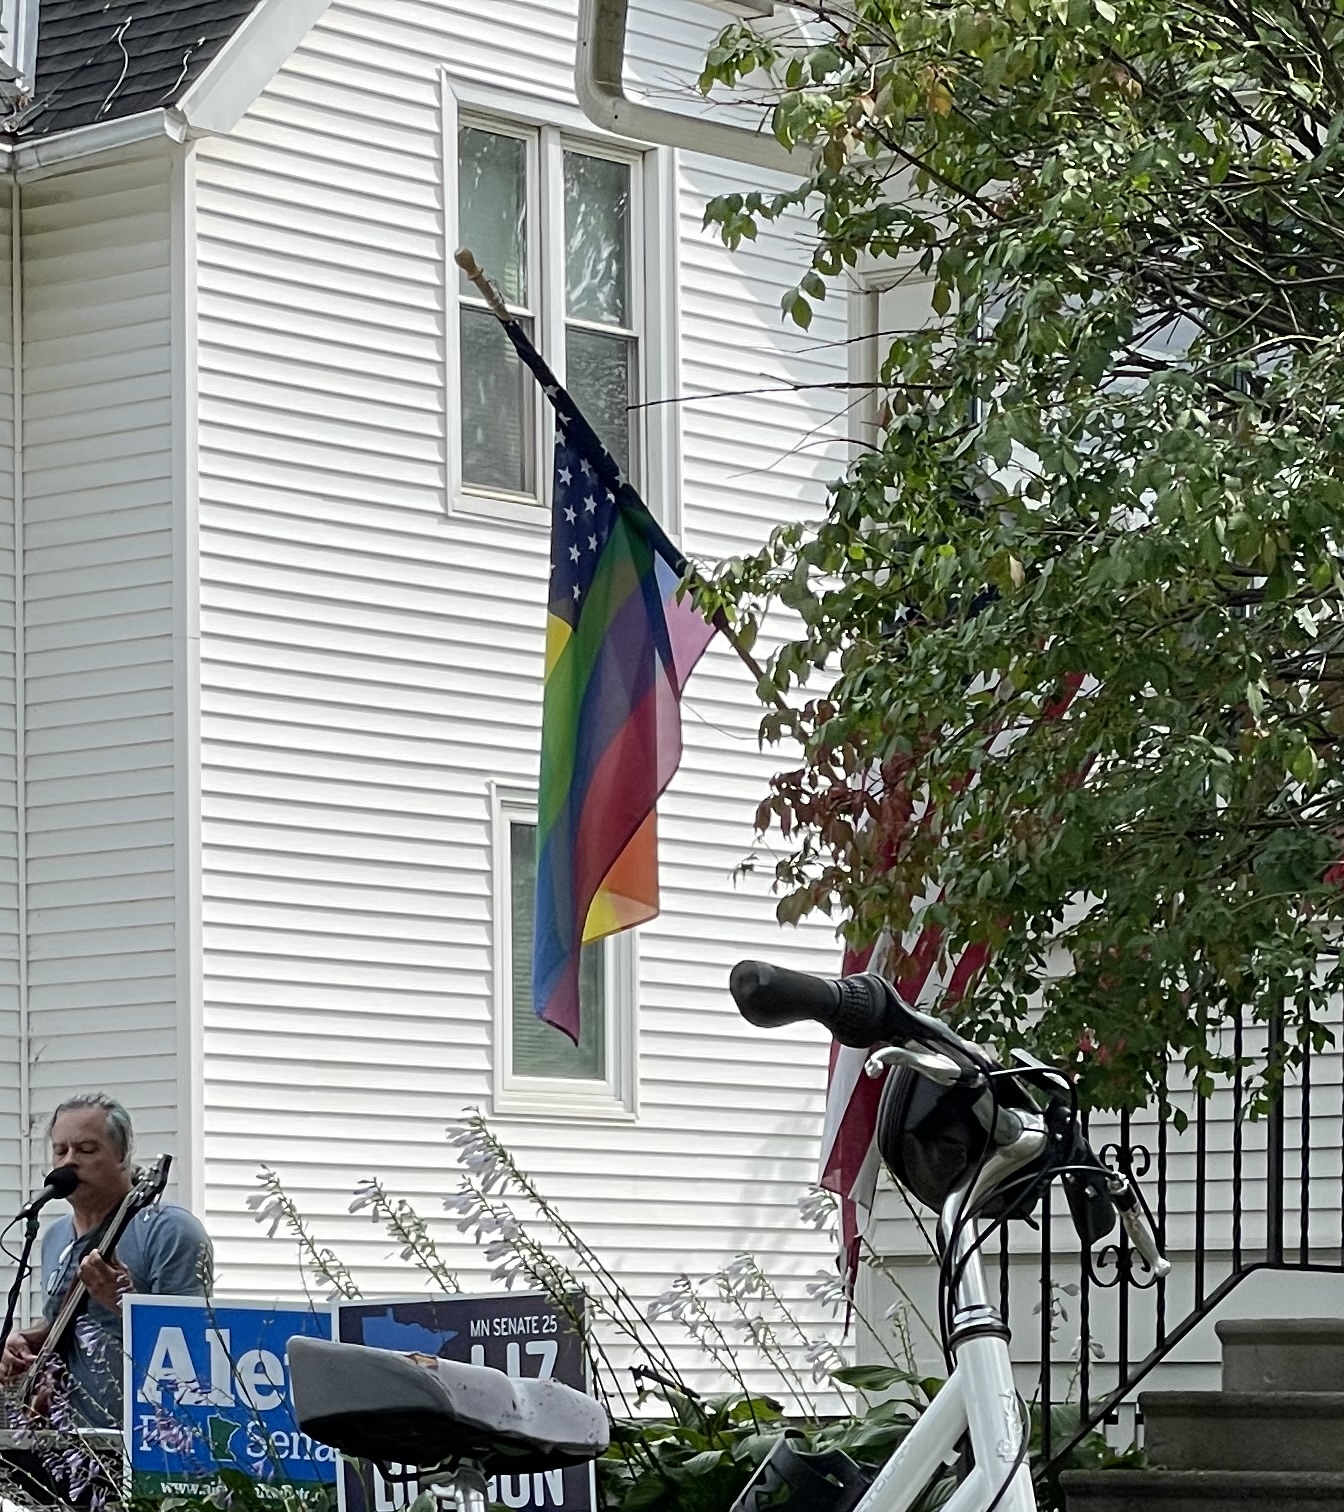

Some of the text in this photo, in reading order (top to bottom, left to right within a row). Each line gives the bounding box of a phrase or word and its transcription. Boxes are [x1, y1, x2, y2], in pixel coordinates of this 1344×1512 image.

[470, 1314, 558, 1338] MN SENATE 25
[136, 1326, 296, 1412] Ale
